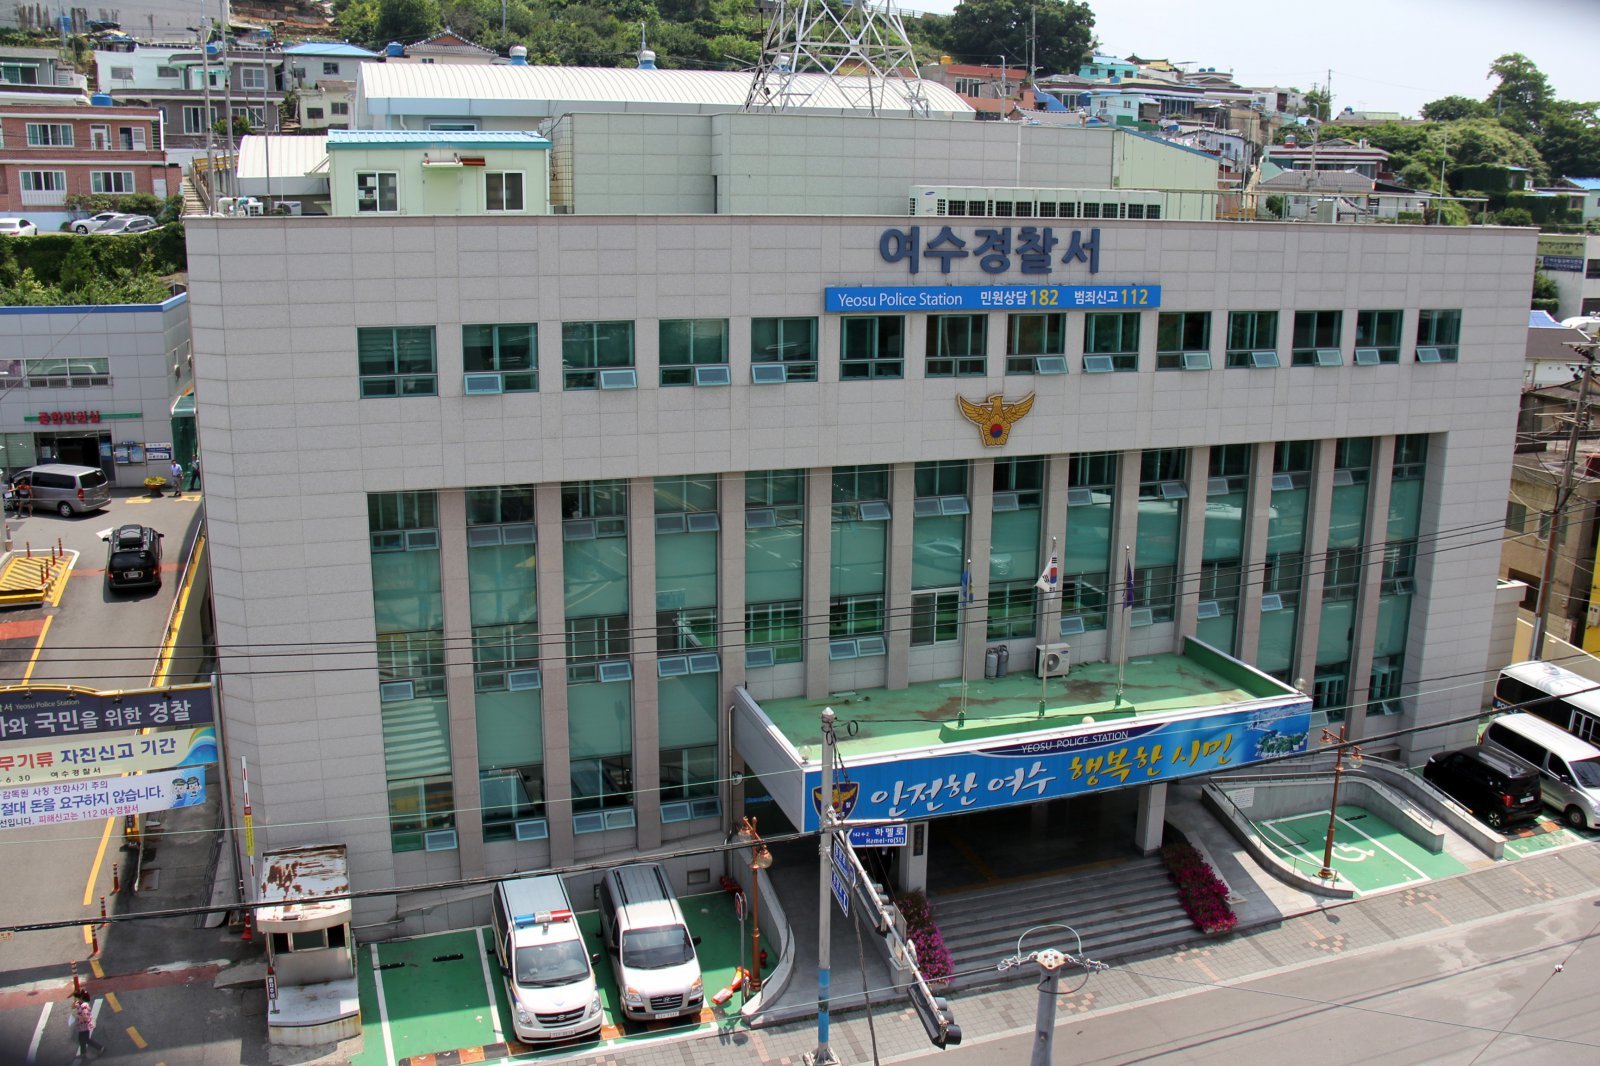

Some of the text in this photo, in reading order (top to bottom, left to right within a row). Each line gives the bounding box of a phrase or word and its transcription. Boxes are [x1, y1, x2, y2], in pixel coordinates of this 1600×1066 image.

[879, 225, 1101, 274] 여수경찰서
[838, 292, 963, 307] Yeosu Police Station
[980, 289, 1148, 306] 민원상담 182 범죄신고 112
[57, 699, 80, 707] Station
[34, 709, 99, 733] 국민을
[105, 706, 142, 727] 위한
[149, 699, 191, 723] 경찰
[60, 743, 134, 764] 자진신고
[140, 737, 176, 756] 기간
[1021, 730, 1129, 754] YEOSU POLICE STATION
[870, 733, 1233, 818] 안전한 여수 행복한 시민
[0, 789, 29, 800] 감독원
[91, 780, 108, 790] 주의
[1, 785, 164, 817] 절대 돈을 요구하지 않습니다.
[82, 809, 98, 818] 112
[100, 804, 139, 817] 여수경찰서
